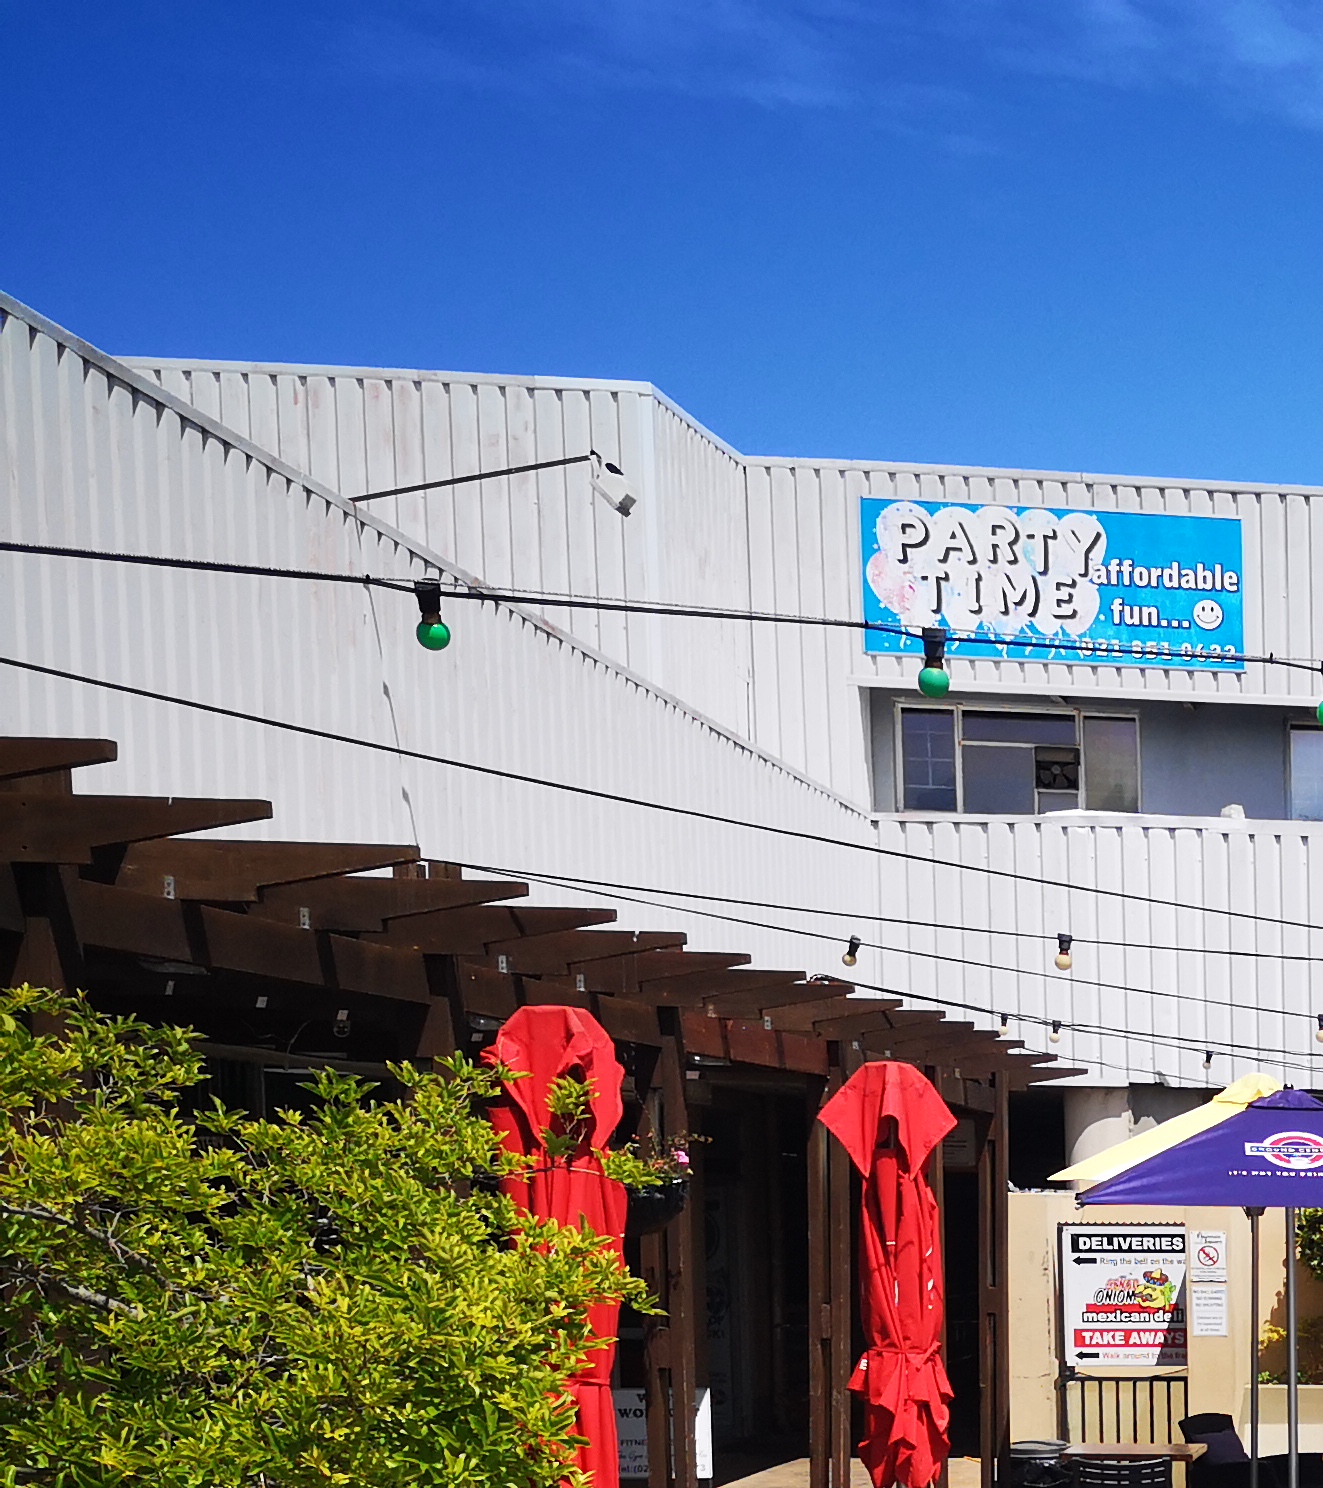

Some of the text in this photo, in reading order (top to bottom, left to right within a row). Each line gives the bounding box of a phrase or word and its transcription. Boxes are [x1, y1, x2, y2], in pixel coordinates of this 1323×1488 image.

[896, 515, 1102, 578] PARTY
[1092, 559, 1239, 592] affordable
[922, 570, 1078, 620] TIME
[1078, 1237, 1184, 1250] DELIVERIES
[1120, 1257, 1132, 1265] the
[1162, 1257, 1174, 1265] the
[1083, 1310, 1182, 1322] mexican deli
[1081, 1331, 1184, 1344] TAKE AWAYS
